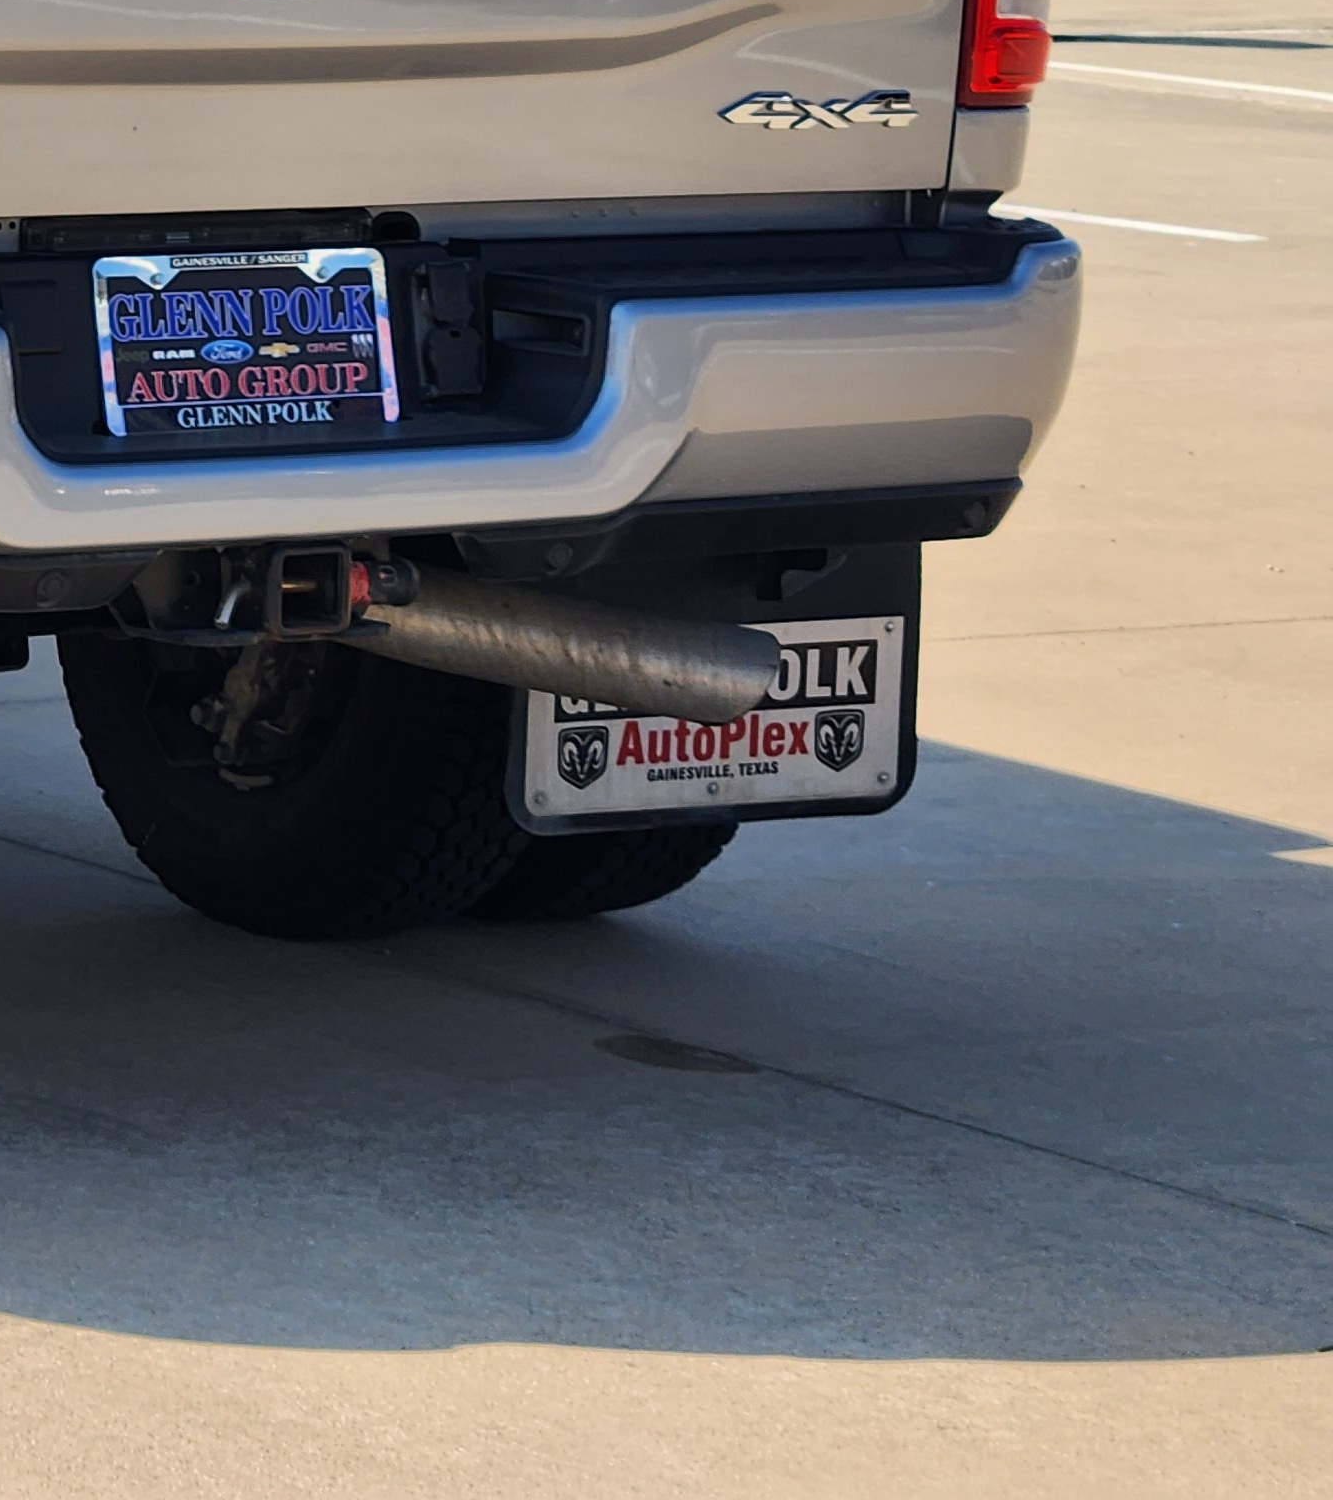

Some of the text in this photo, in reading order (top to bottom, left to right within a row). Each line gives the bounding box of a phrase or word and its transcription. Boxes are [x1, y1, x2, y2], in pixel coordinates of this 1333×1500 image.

[172, 255, 248, 268] GAINESVILLE
[258, 253, 306, 265] SANGER
[109, 285, 375, 342] GLENN POLK
[152, 348, 195, 360] RAM
[210, 346, 243, 361] Ford
[306, 342, 347, 354] GMC
[127, 362, 369, 402] AUTO GROUP
[177, 400, 333, 429] GLENN POLK
[767, 645, 869, 701] OLK
[616, 713, 809, 766] AutoPlex
[647, 761, 779, 782] GAINESVILLE, TEXAS
